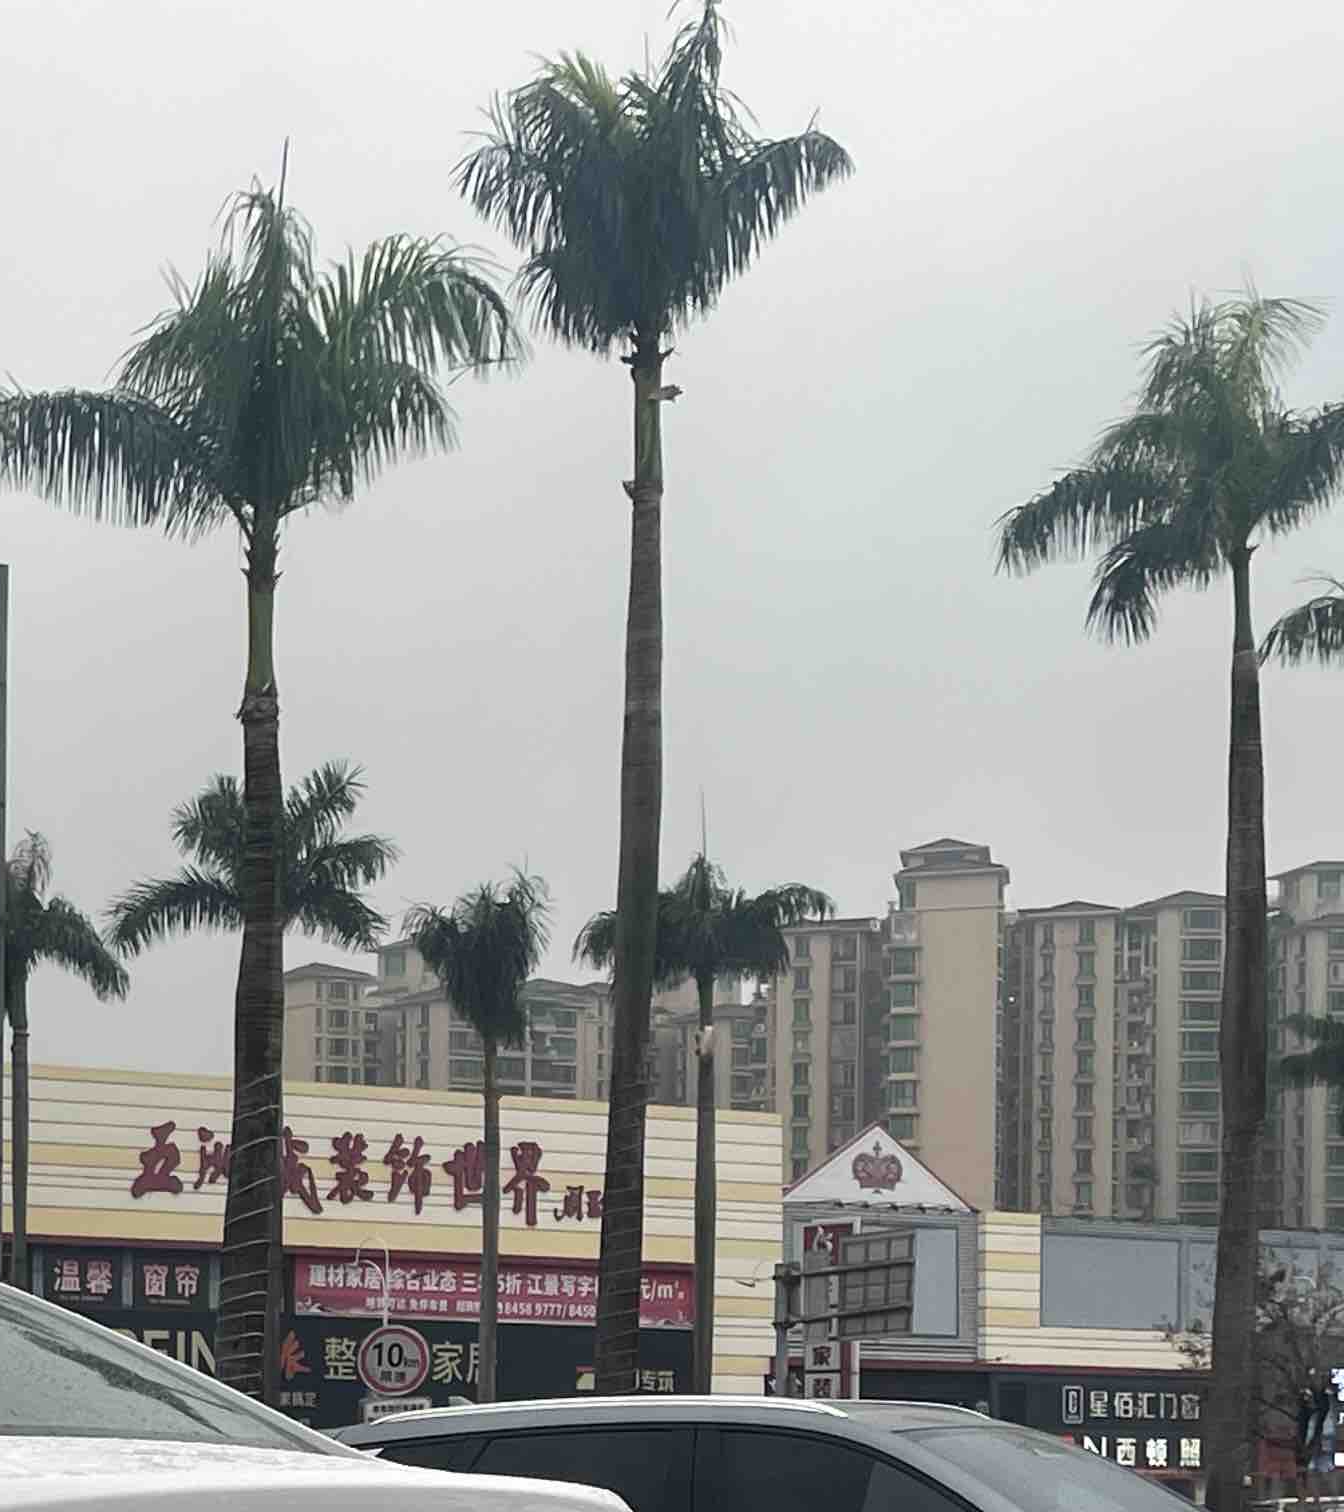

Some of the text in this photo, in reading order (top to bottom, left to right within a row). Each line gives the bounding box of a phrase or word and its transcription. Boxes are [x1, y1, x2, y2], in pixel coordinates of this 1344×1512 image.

[53, 1259, 201, 1298] 温馨 窗帘
[372, 1342, 404, 1368] 10
[1089, 1390, 1201, 1419] 星佰汇门窗
